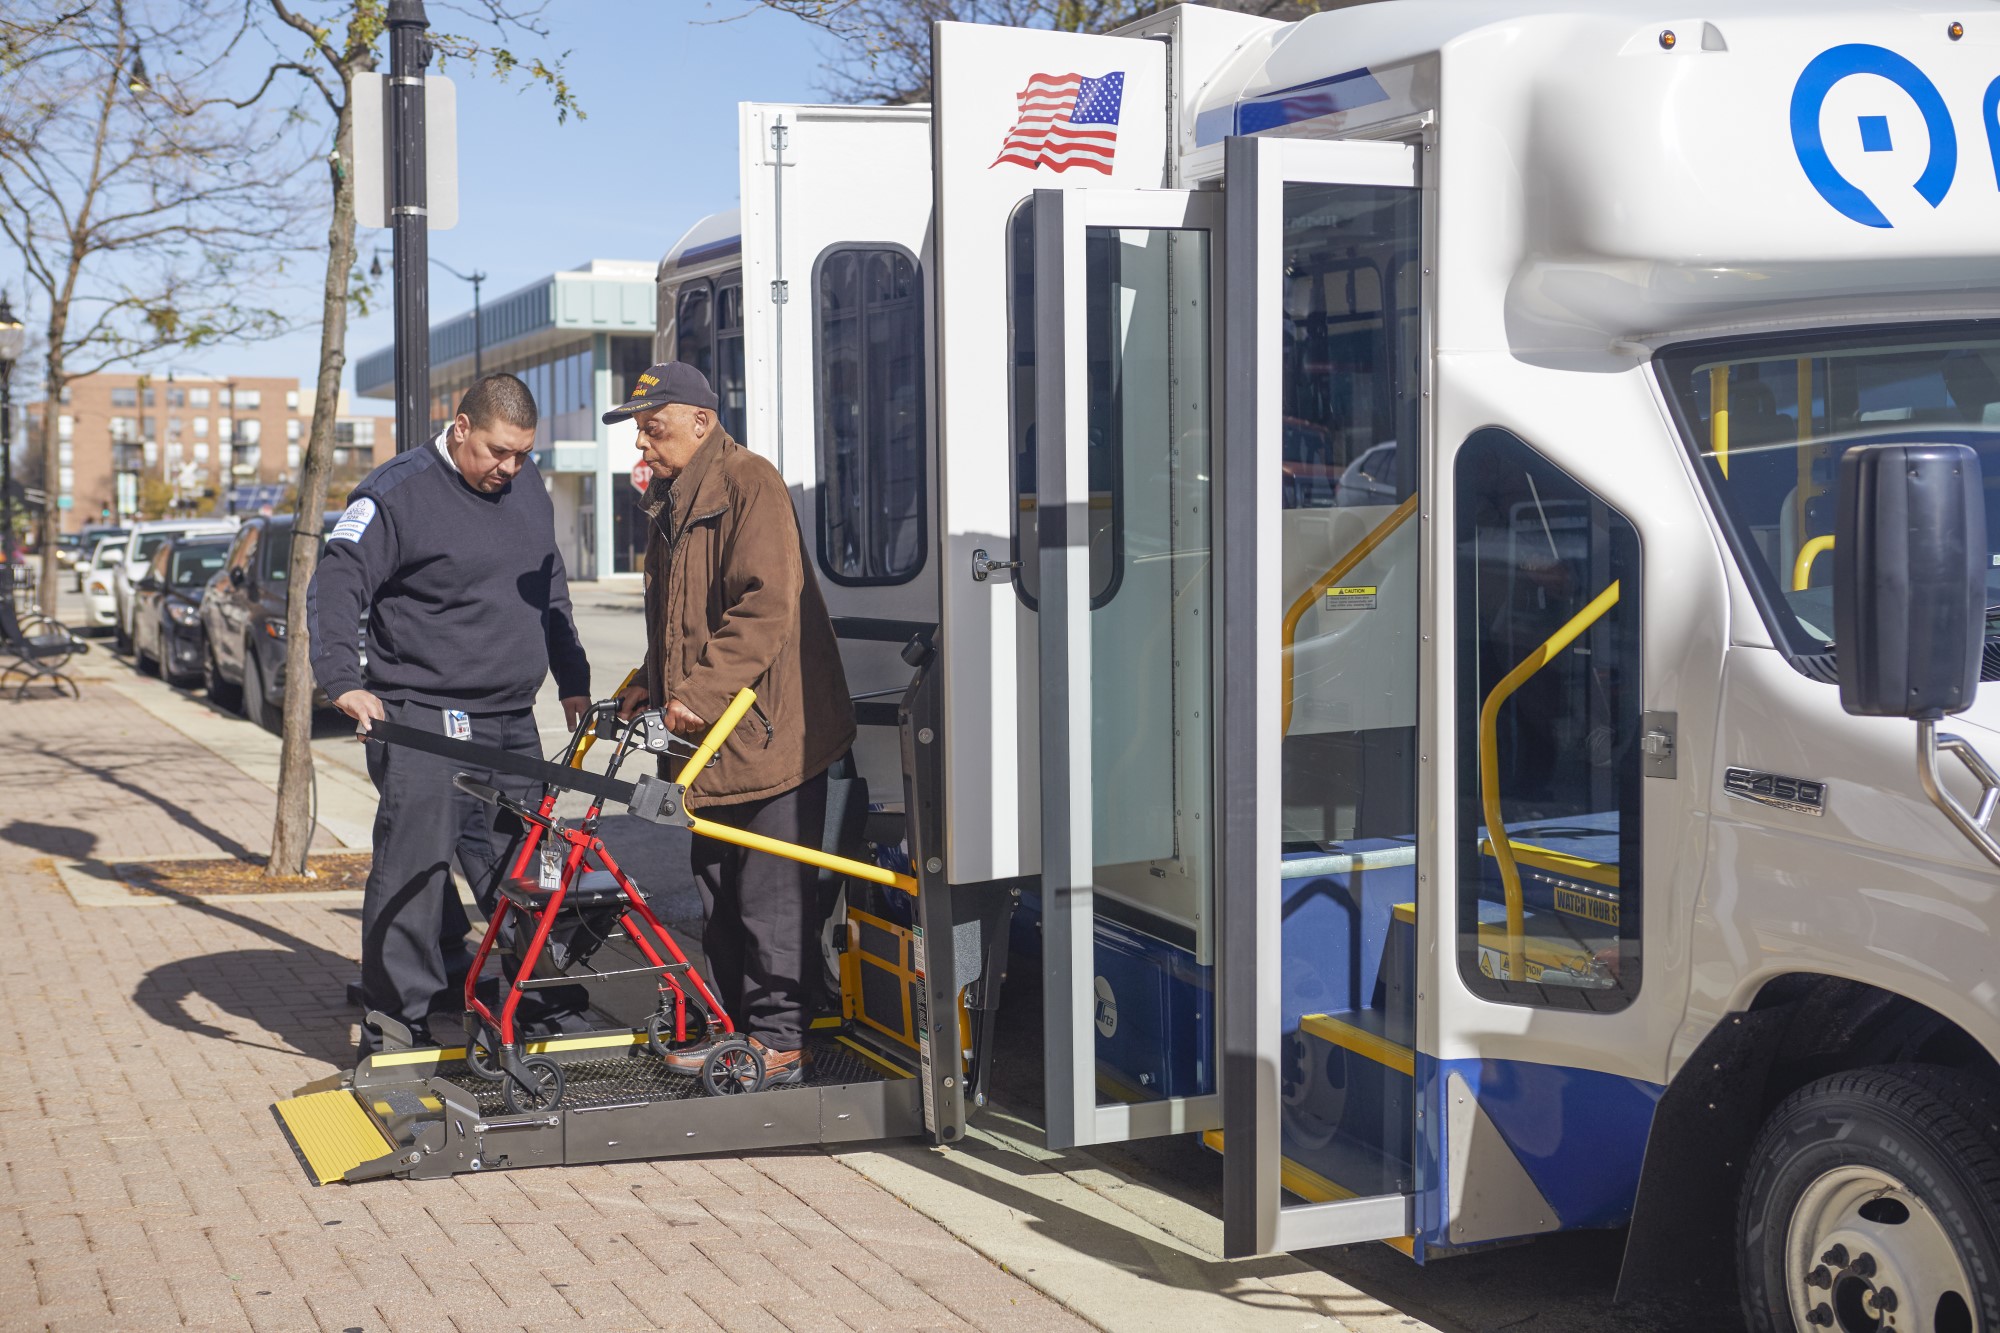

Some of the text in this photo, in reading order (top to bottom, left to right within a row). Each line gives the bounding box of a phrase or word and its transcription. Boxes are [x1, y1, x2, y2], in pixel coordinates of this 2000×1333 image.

[634, 466, 652, 483] ST
[1765, 799, 1819, 815] SUPER DUTY
[1557, 889, 1620, 924] WATCH YOUR S
[1526, 964, 1542, 977] TION
[1879, 1134, 1988, 1283] Dynapro
